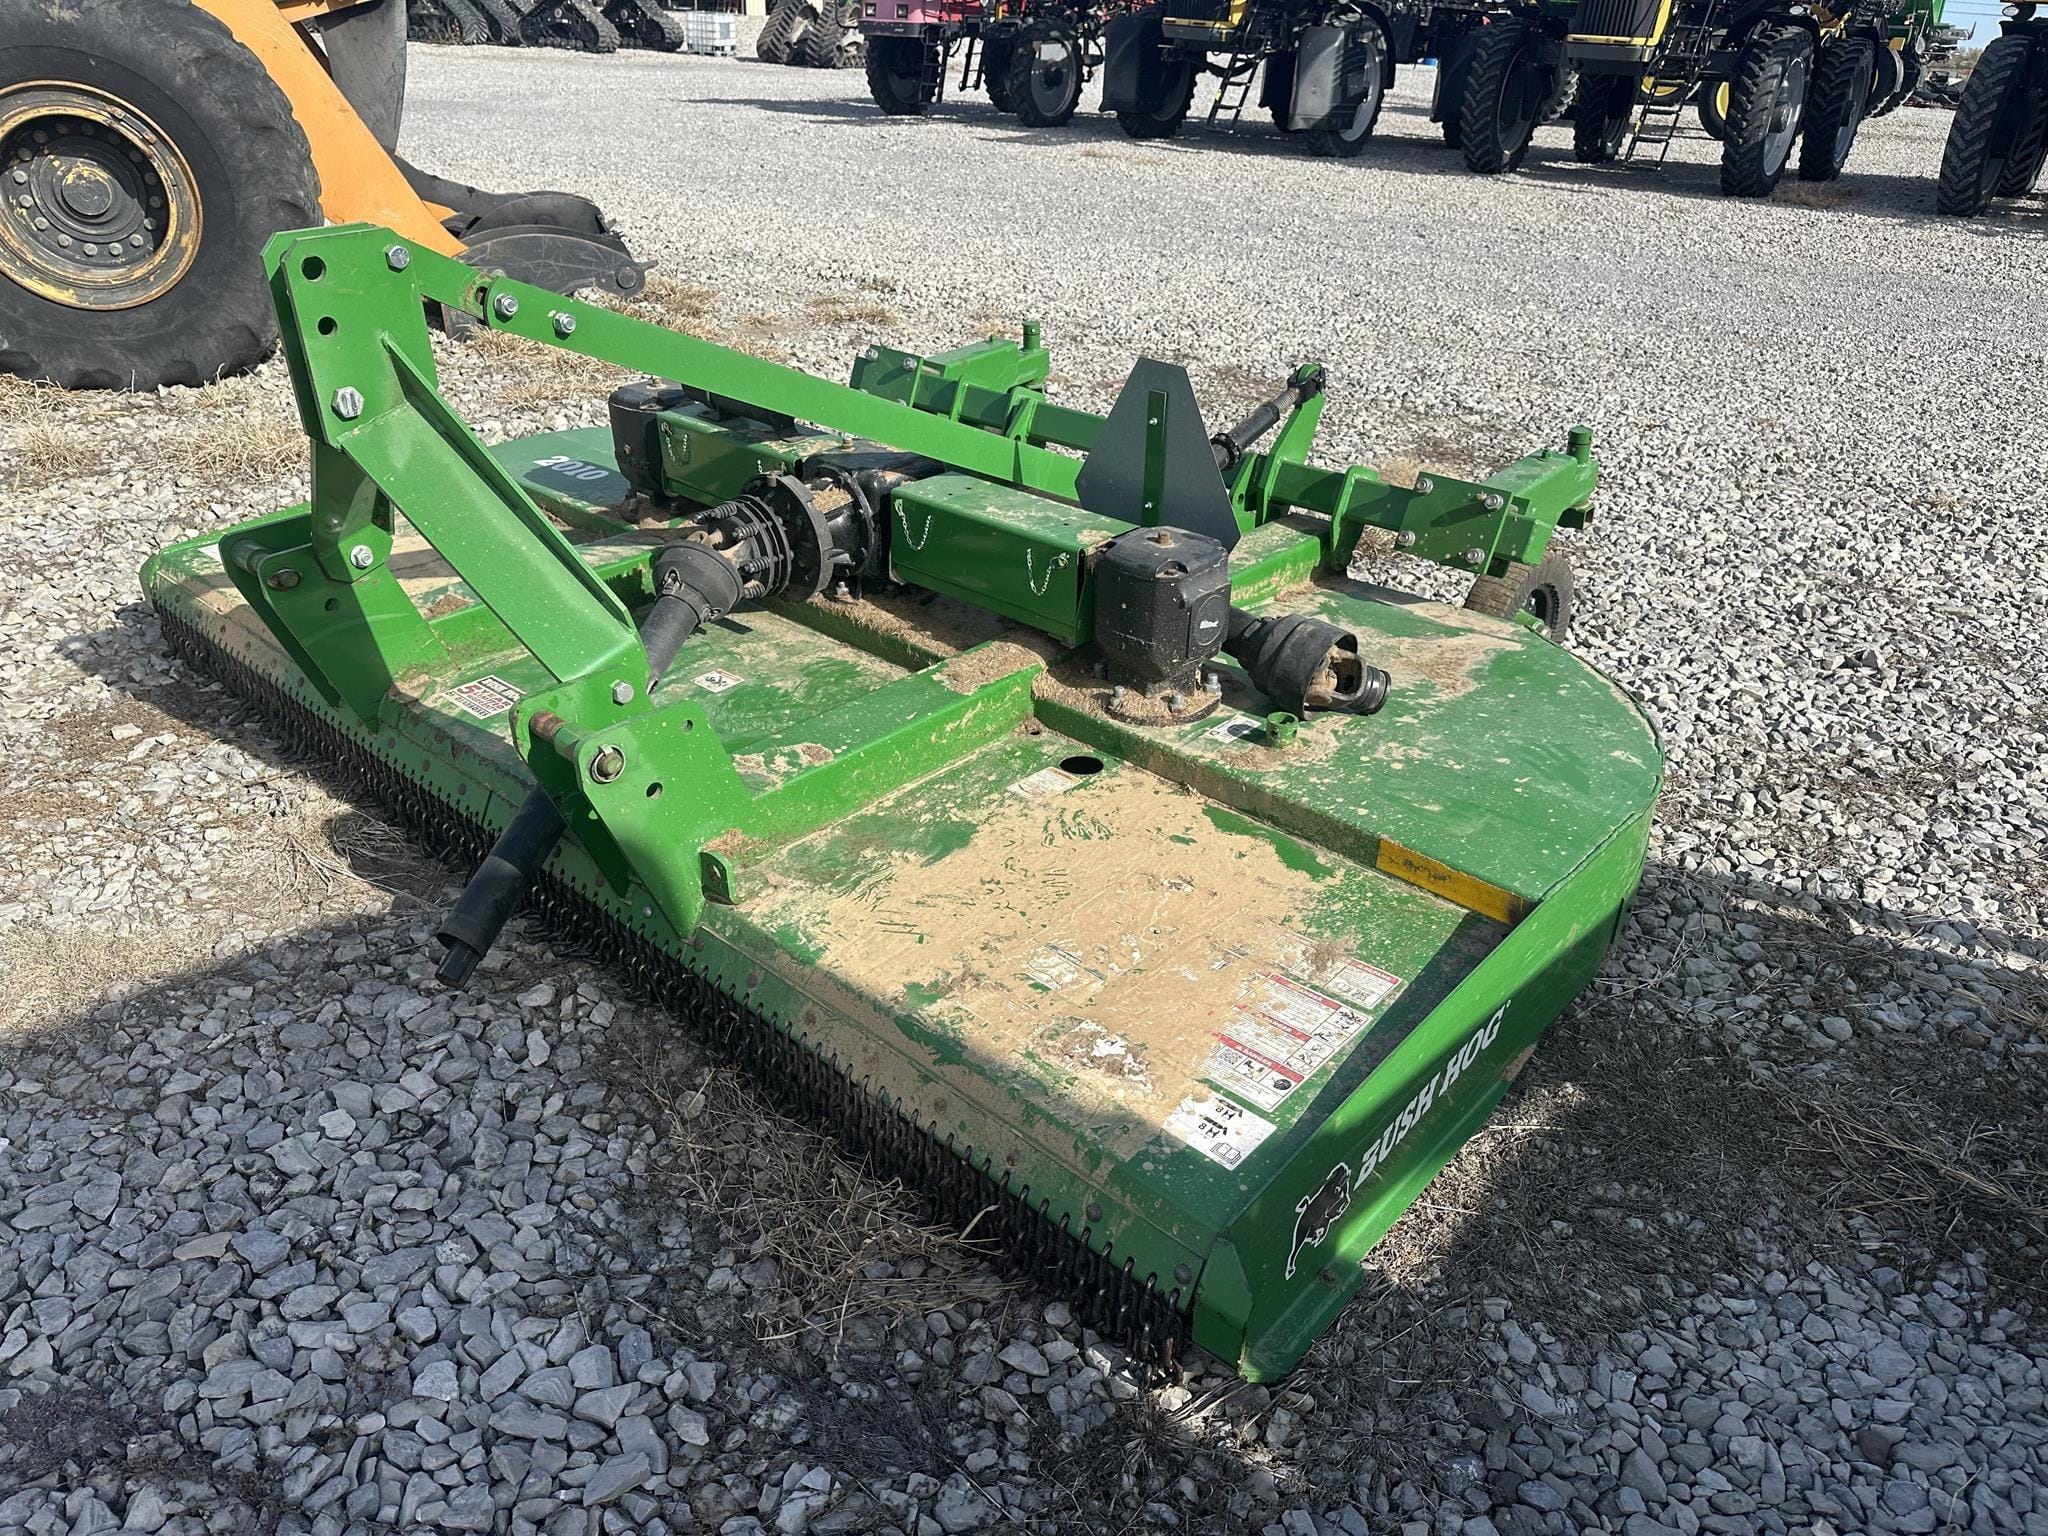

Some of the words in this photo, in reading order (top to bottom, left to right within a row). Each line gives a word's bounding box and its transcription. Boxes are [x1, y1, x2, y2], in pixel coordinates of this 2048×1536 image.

[533, 456, 609, 480] 2010
[457, 684, 482, 694] 5
[1243, 1048, 1273, 1067] DANGER
[1353, 1071, 1441, 1191] BUSH
[1438, 1004, 1506, 1098] HOG
